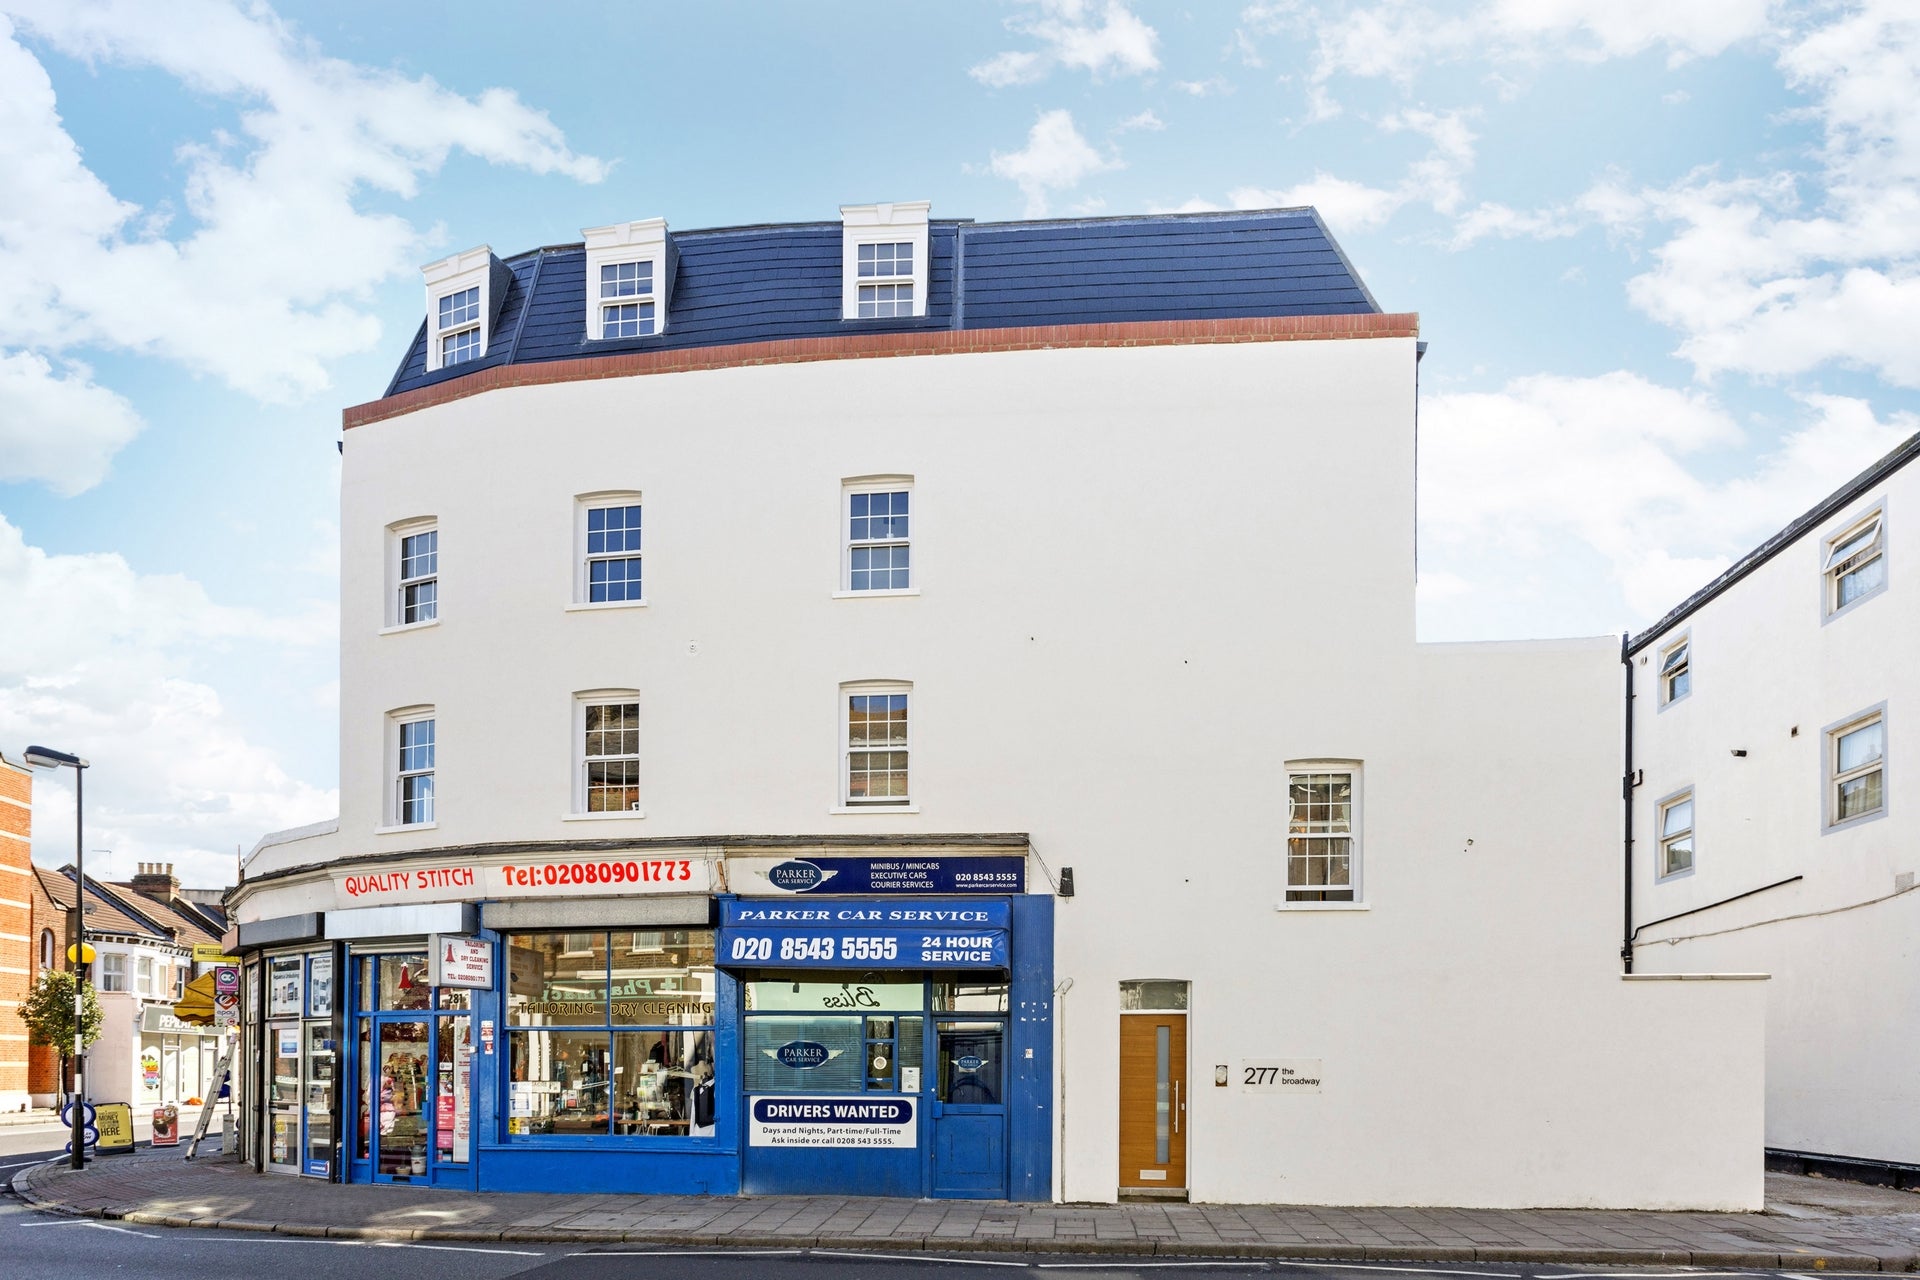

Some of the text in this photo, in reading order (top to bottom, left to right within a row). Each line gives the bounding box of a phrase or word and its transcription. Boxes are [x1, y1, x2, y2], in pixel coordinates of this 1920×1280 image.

[906, 862, 940, 870] MINICABS
[503, 861, 691, 886] Tel:02080901773
[776, 869, 816, 879] PARKER
[870, 871, 927, 879] EXECUTIVE CARS
[955, 873, 1017, 881] 020 8543 5555
[345, 868, 474, 896] QUALITY STITCH
[738, 910, 989, 922] PARKER CAR SERVICE
[922, 937, 993, 948] 24 HOUR
[732, 937, 897, 960] 020 8543 5555
[922, 951, 991, 961] SERVICE
[448, 994, 463, 1004] 281
[519, 1002, 595, 1016] TAILORING
[611, 1002, 711, 1016] DRY CLEANING
[784, 1048, 822, 1057] PARKER
[1244, 1067, 1279, 1085] 277
[1281, 1077, 1320, 1086] broadway
[767, 1105, 900, 1119] DRIVERS WANTED
[101, 1127, 121, 1136] HERE
[762, 1127, 781, 1135] Days
[799, 1127, 826, 1136] Nights,
[827, 1127, 902, 1135] Part-time/Full-Time
